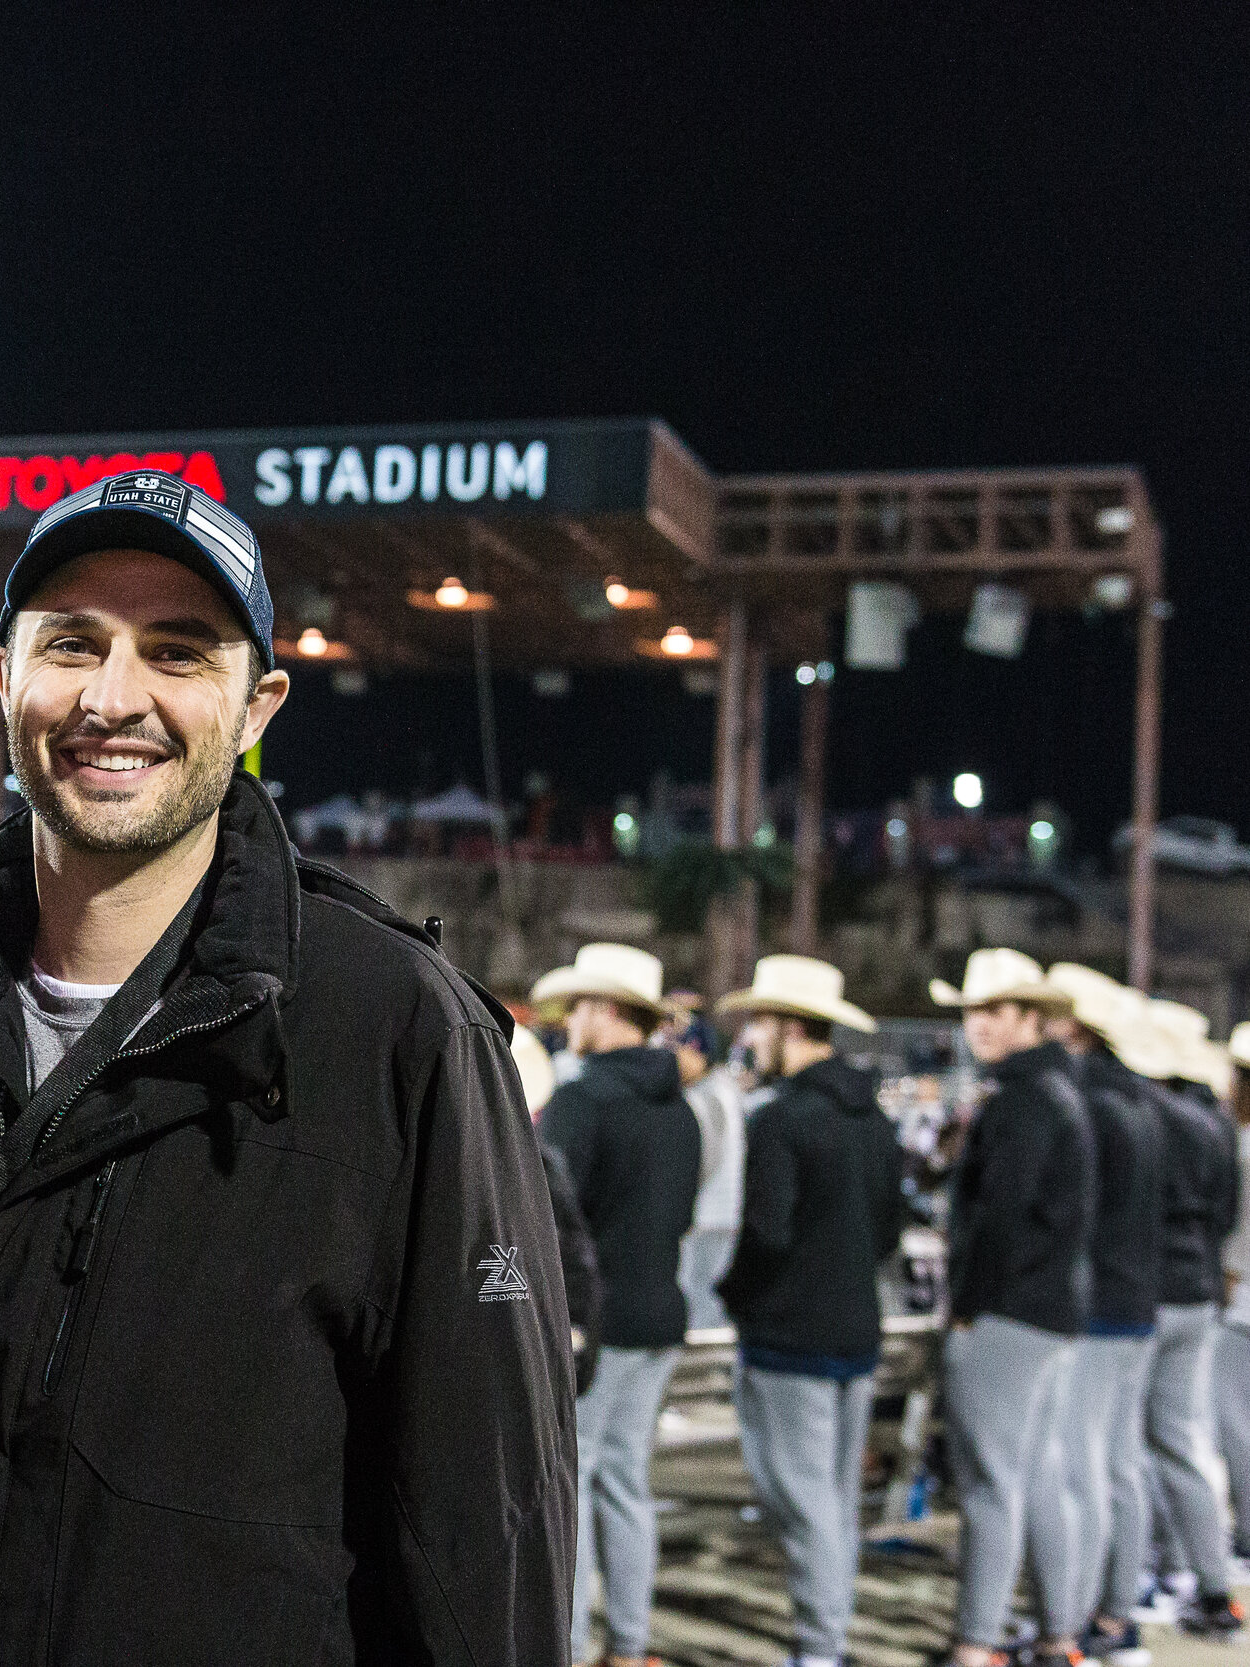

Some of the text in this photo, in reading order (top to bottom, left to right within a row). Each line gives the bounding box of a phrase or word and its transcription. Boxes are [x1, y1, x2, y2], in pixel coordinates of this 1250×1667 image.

[255, 440, 548, 507] STADIUM
[109, 492, 180, 508] UTAH STATE
